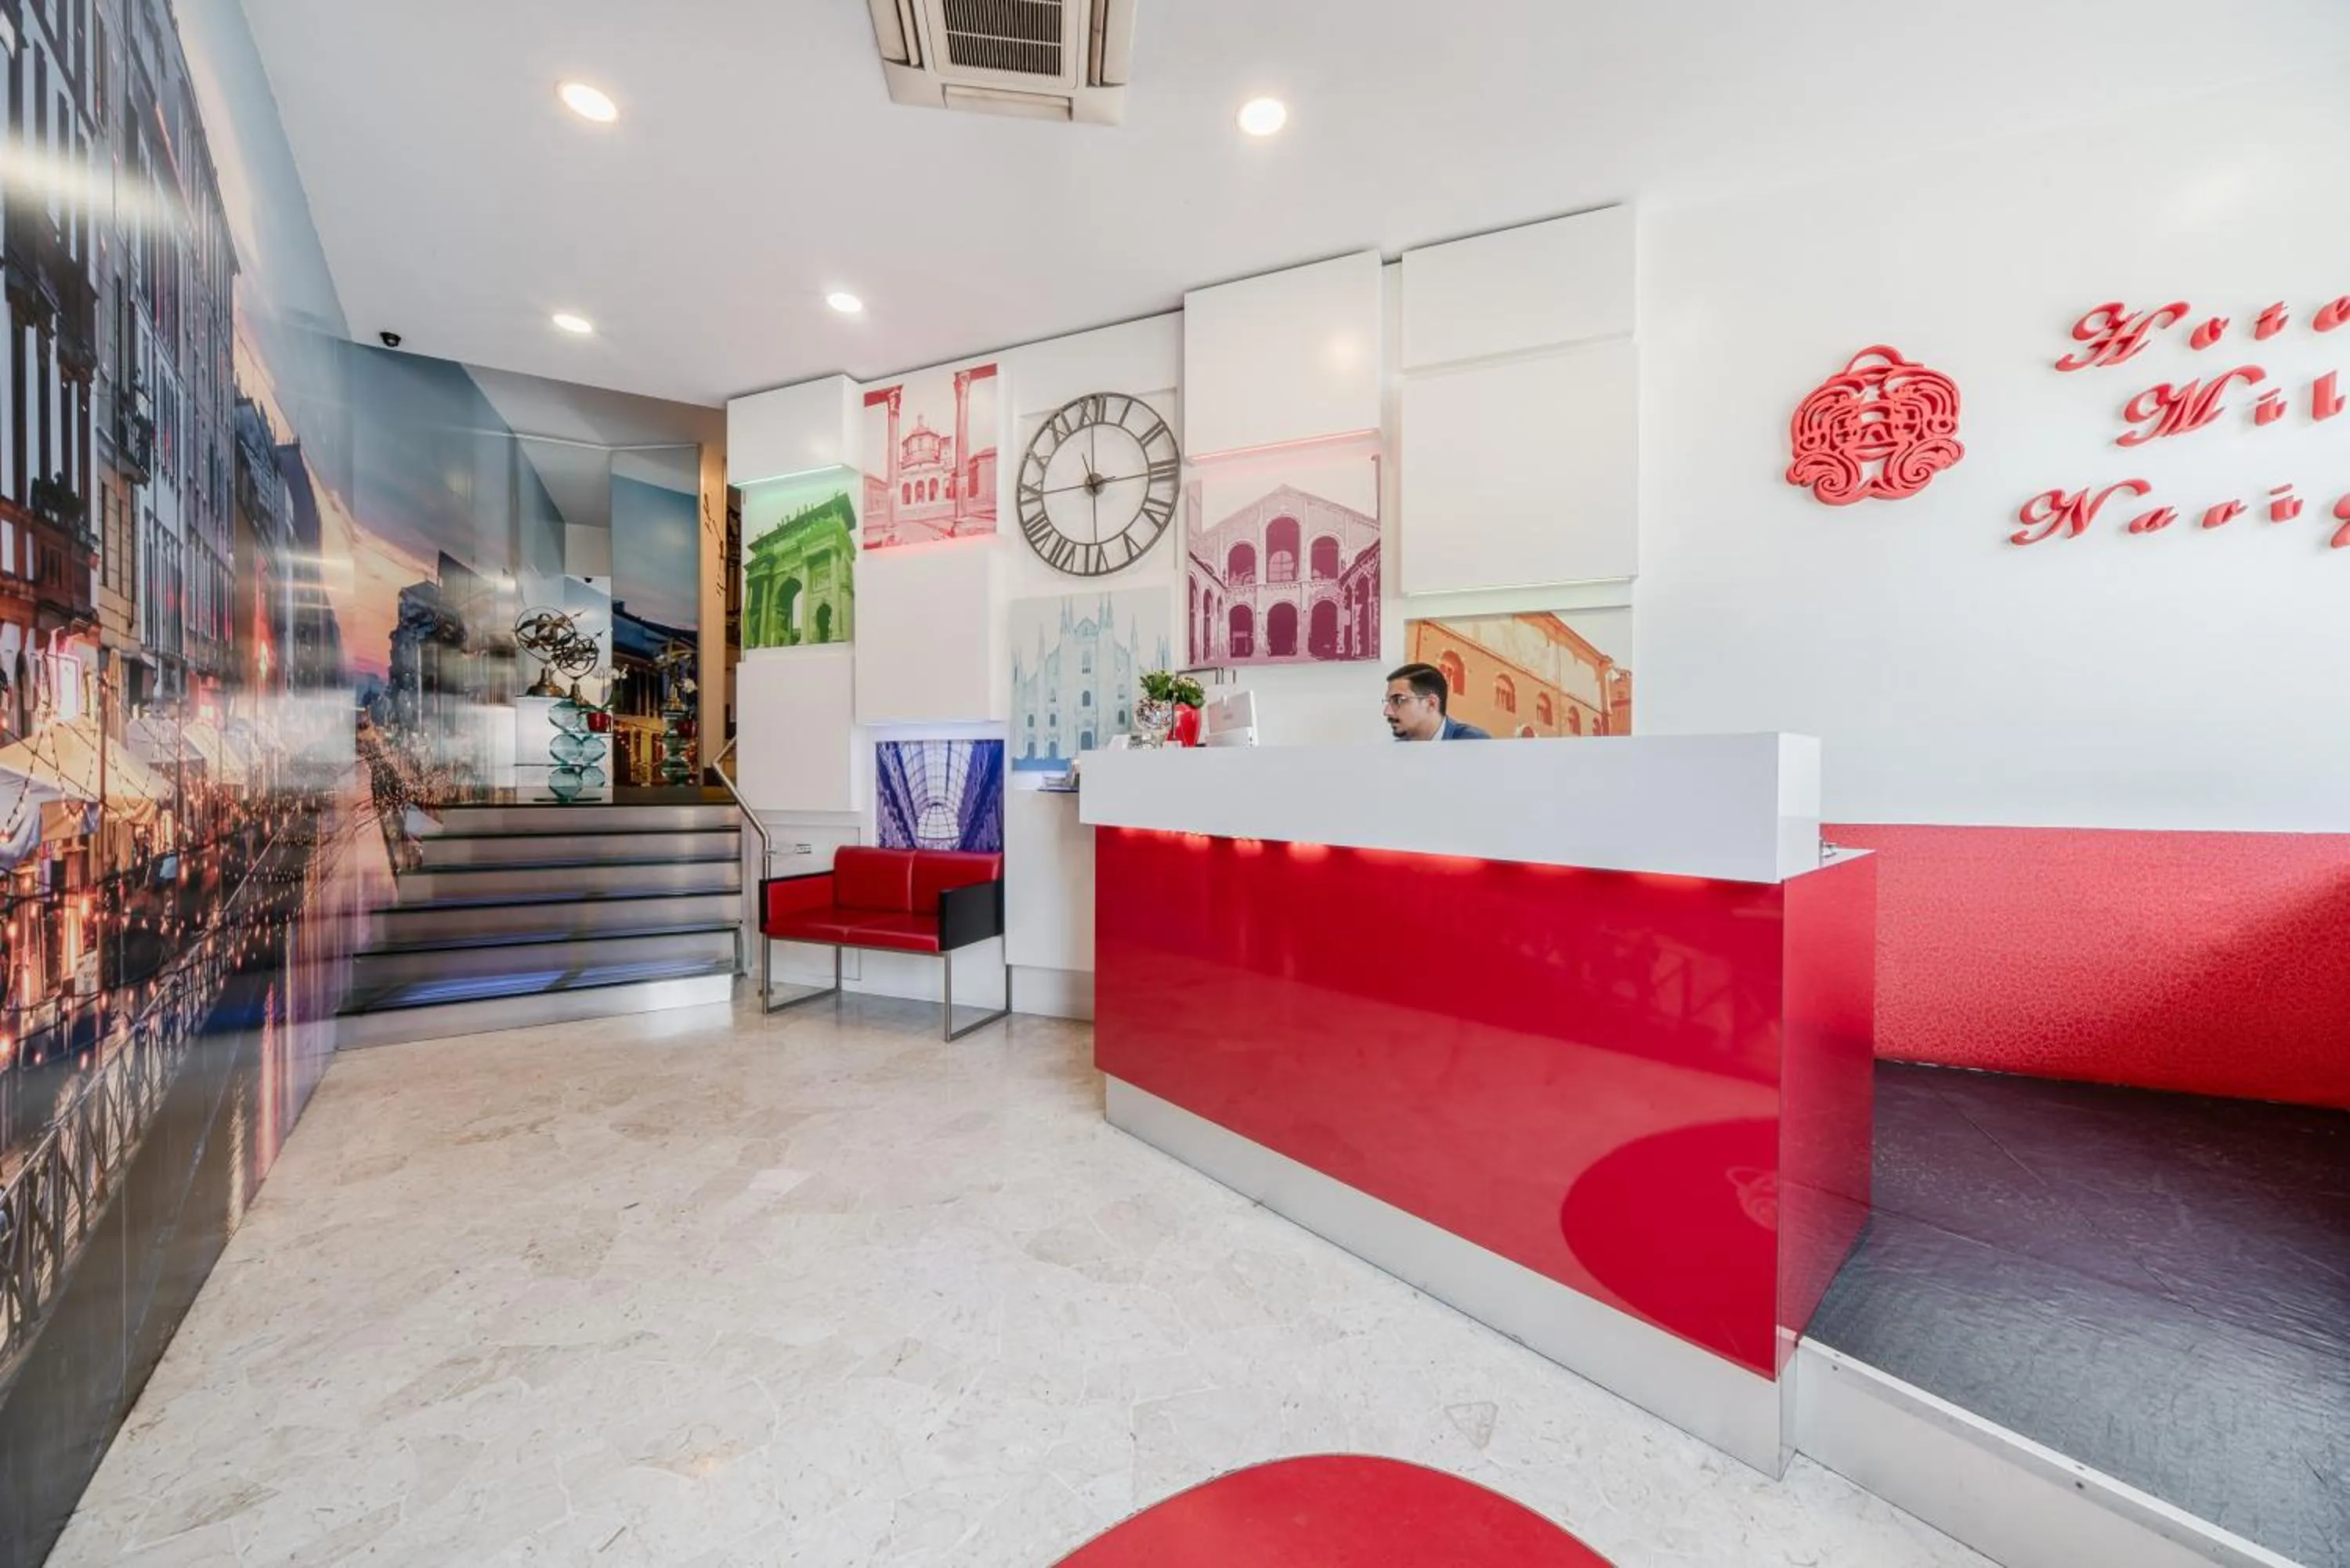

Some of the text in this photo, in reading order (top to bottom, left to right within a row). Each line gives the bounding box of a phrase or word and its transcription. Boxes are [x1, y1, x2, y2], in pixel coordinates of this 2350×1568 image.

[2054, 294, 2350, 372] Hote
[1077, 395, 1107, 428] XII
[2115, 364, 2346, 446] Mil
[1047, 410, 1072, 447] XI
[1140, 418, 1167, 447] II
